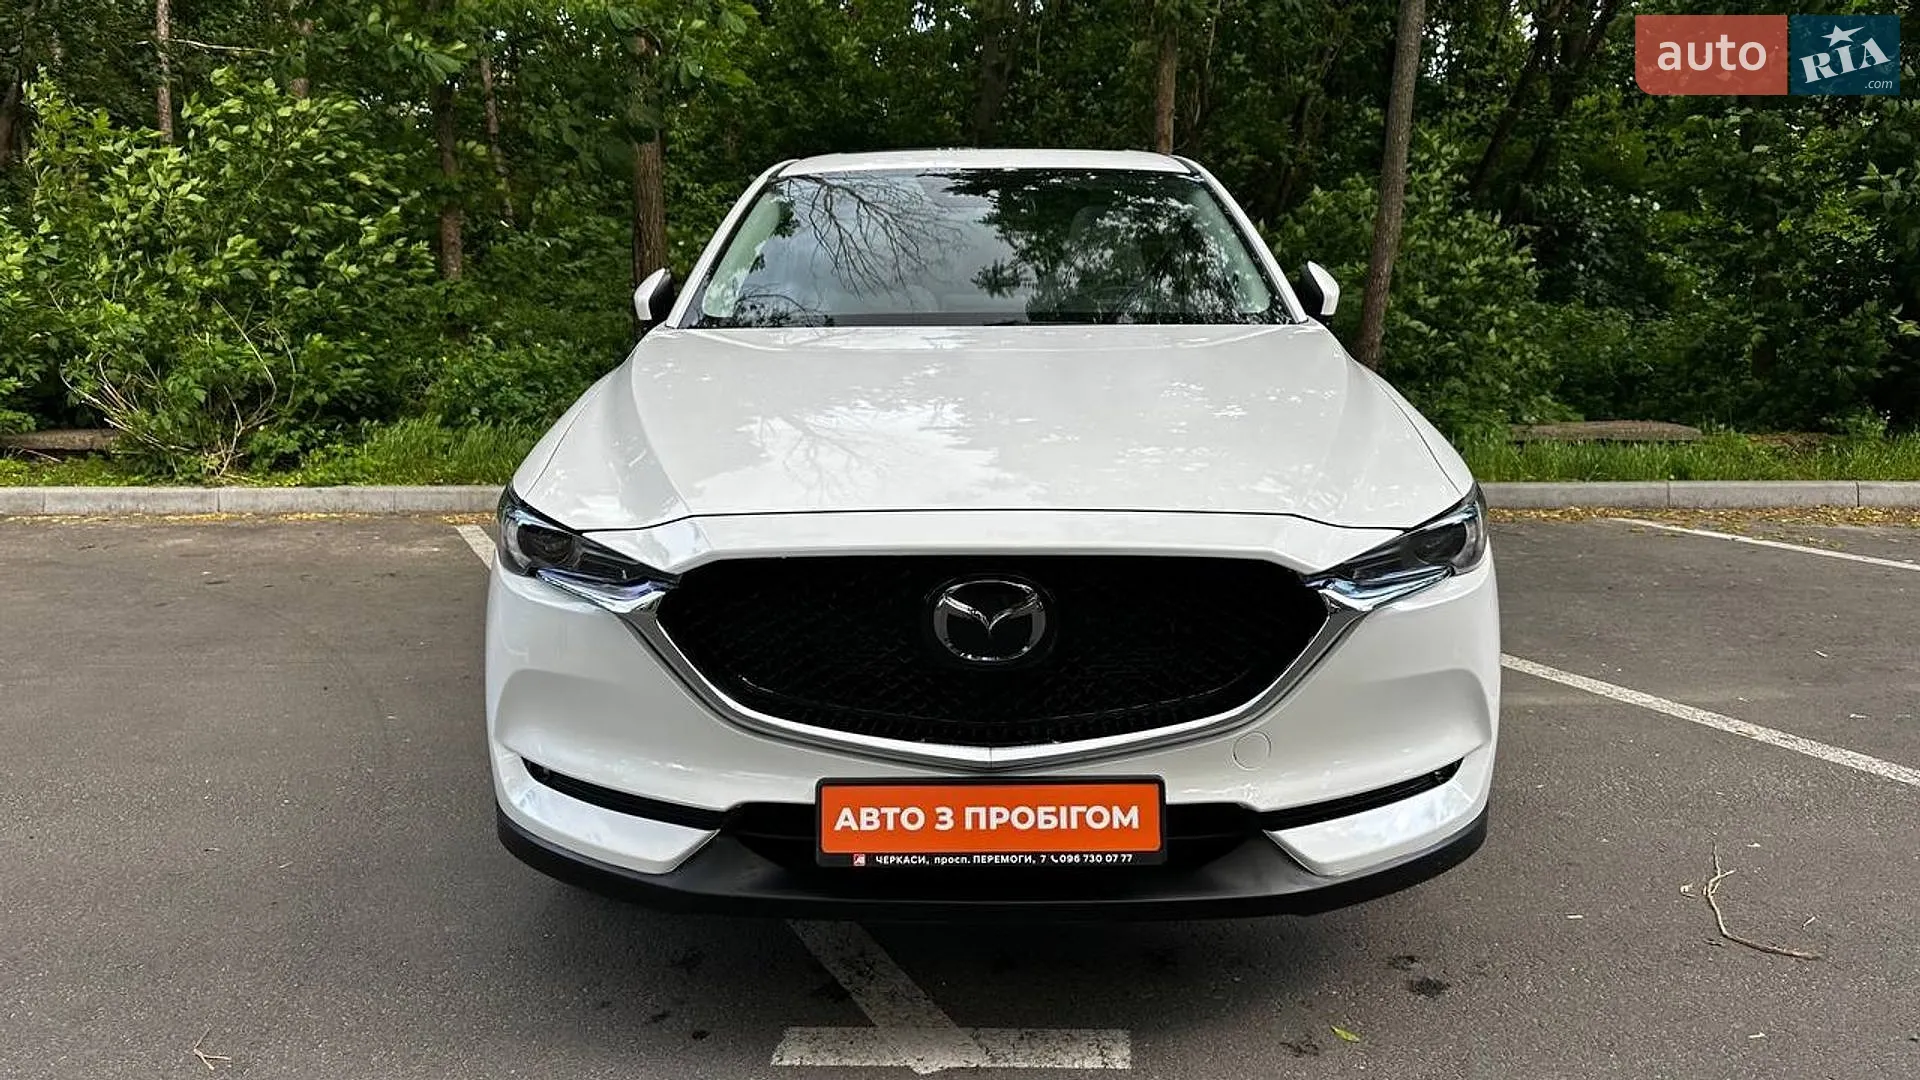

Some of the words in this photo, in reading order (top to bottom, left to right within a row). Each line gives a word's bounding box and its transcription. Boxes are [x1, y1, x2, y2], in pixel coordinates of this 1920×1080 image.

[834, 806, 925, 831] АВТО
[935, 806, 954, 831] З
[966, 805, 1139, 830] ПРОБІГОМ
[875, 855, 930, 865] ЧЕРКАСИ,
[934, 856, 970, 866] просп.
[1040, 854, 1046, 863] 7
[1059, 854, 1080, 864] 096
[1083, 853, 1102, 863] 730
[1105, 853, 1119, 863] 07
[1121, 853, 1133, 863] 77
